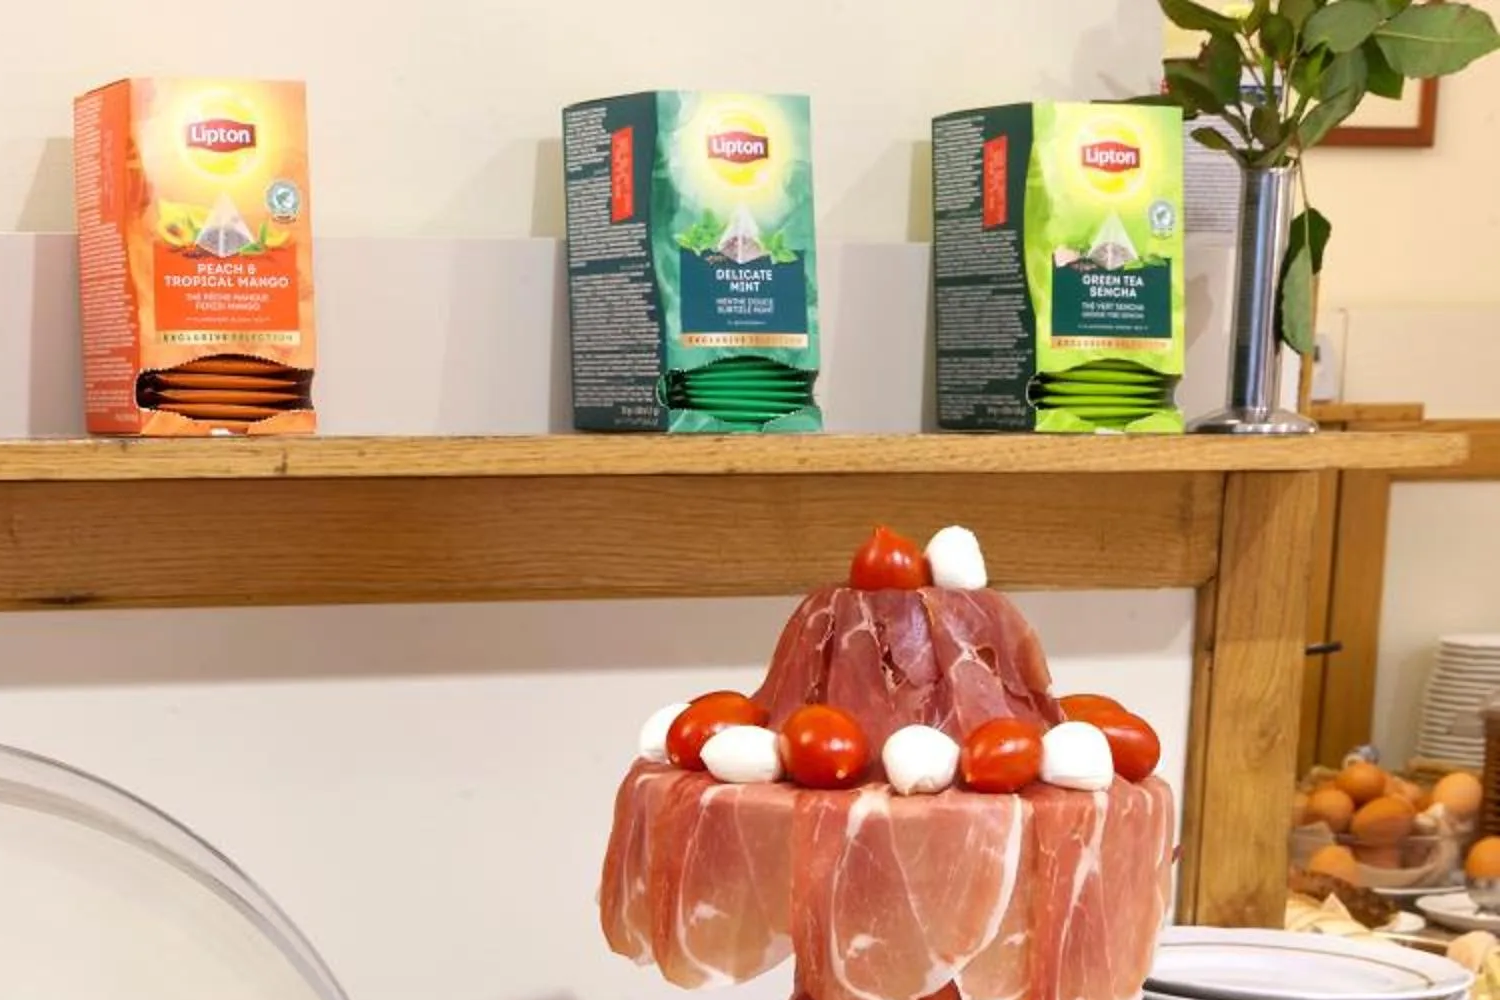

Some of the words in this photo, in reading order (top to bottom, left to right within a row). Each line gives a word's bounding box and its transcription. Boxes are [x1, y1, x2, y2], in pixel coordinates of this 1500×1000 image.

[191, 126, 251, 145] Lipton
[712, 139, 764, 157] Lipton
[1085, 148, 1136, 166] Lipton
[197, 263, 243, 275] PEACH
[715, 269, 773, 281] DELICATE
[164, 275, 235, 288] TROPICAL
[237, 276, 290, 288] MANGO
[730, 281, 760, 292] MINT
[1082, 275, 1120, 286] GREEN
[1123, 276, 1145, 286] TEA
[1089, 286, 1137, 297] SENCHA
